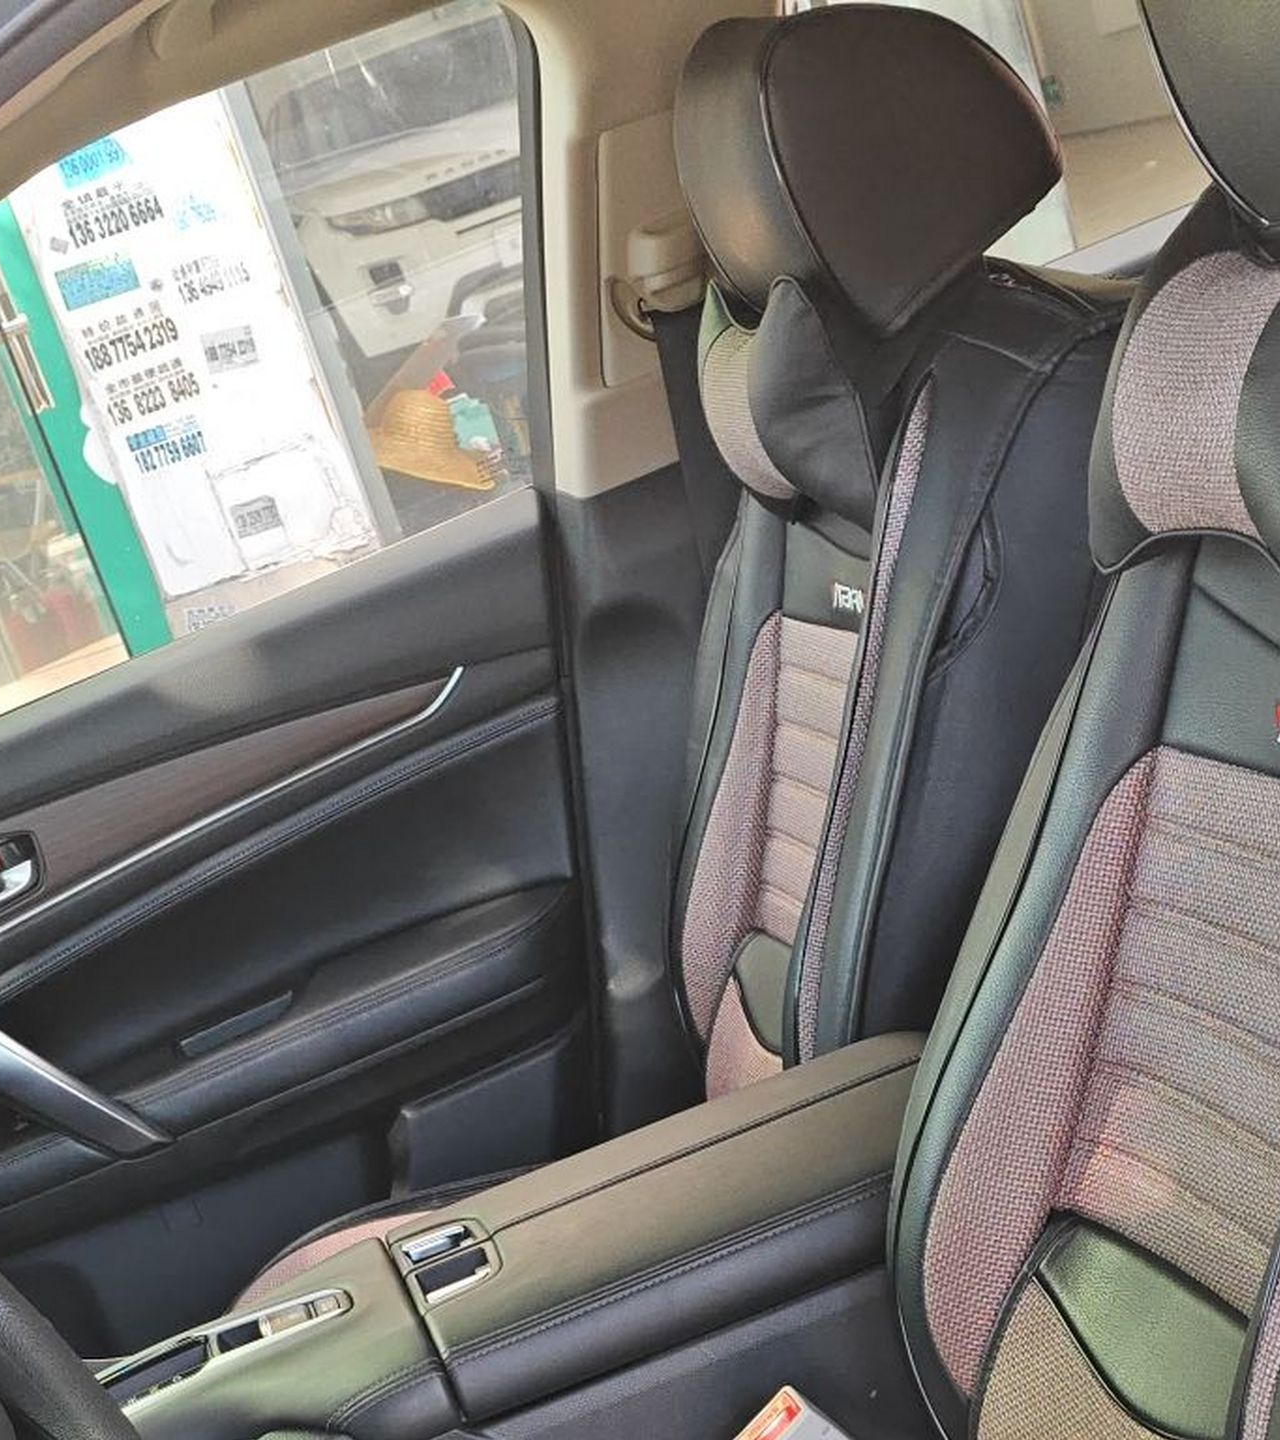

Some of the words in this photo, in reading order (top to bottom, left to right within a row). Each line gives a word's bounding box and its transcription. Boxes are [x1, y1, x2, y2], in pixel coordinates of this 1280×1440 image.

[69, 219, 96, 249] 136
[94, 205, 130, 240] 3220
[84, 342, 113, 373] 188
[109, 328, 146, 362] 7754
[143, 317, 179, 352] 2319
[107, 398, 133, 426] 136
[133, 385, 167, 416] 8223
